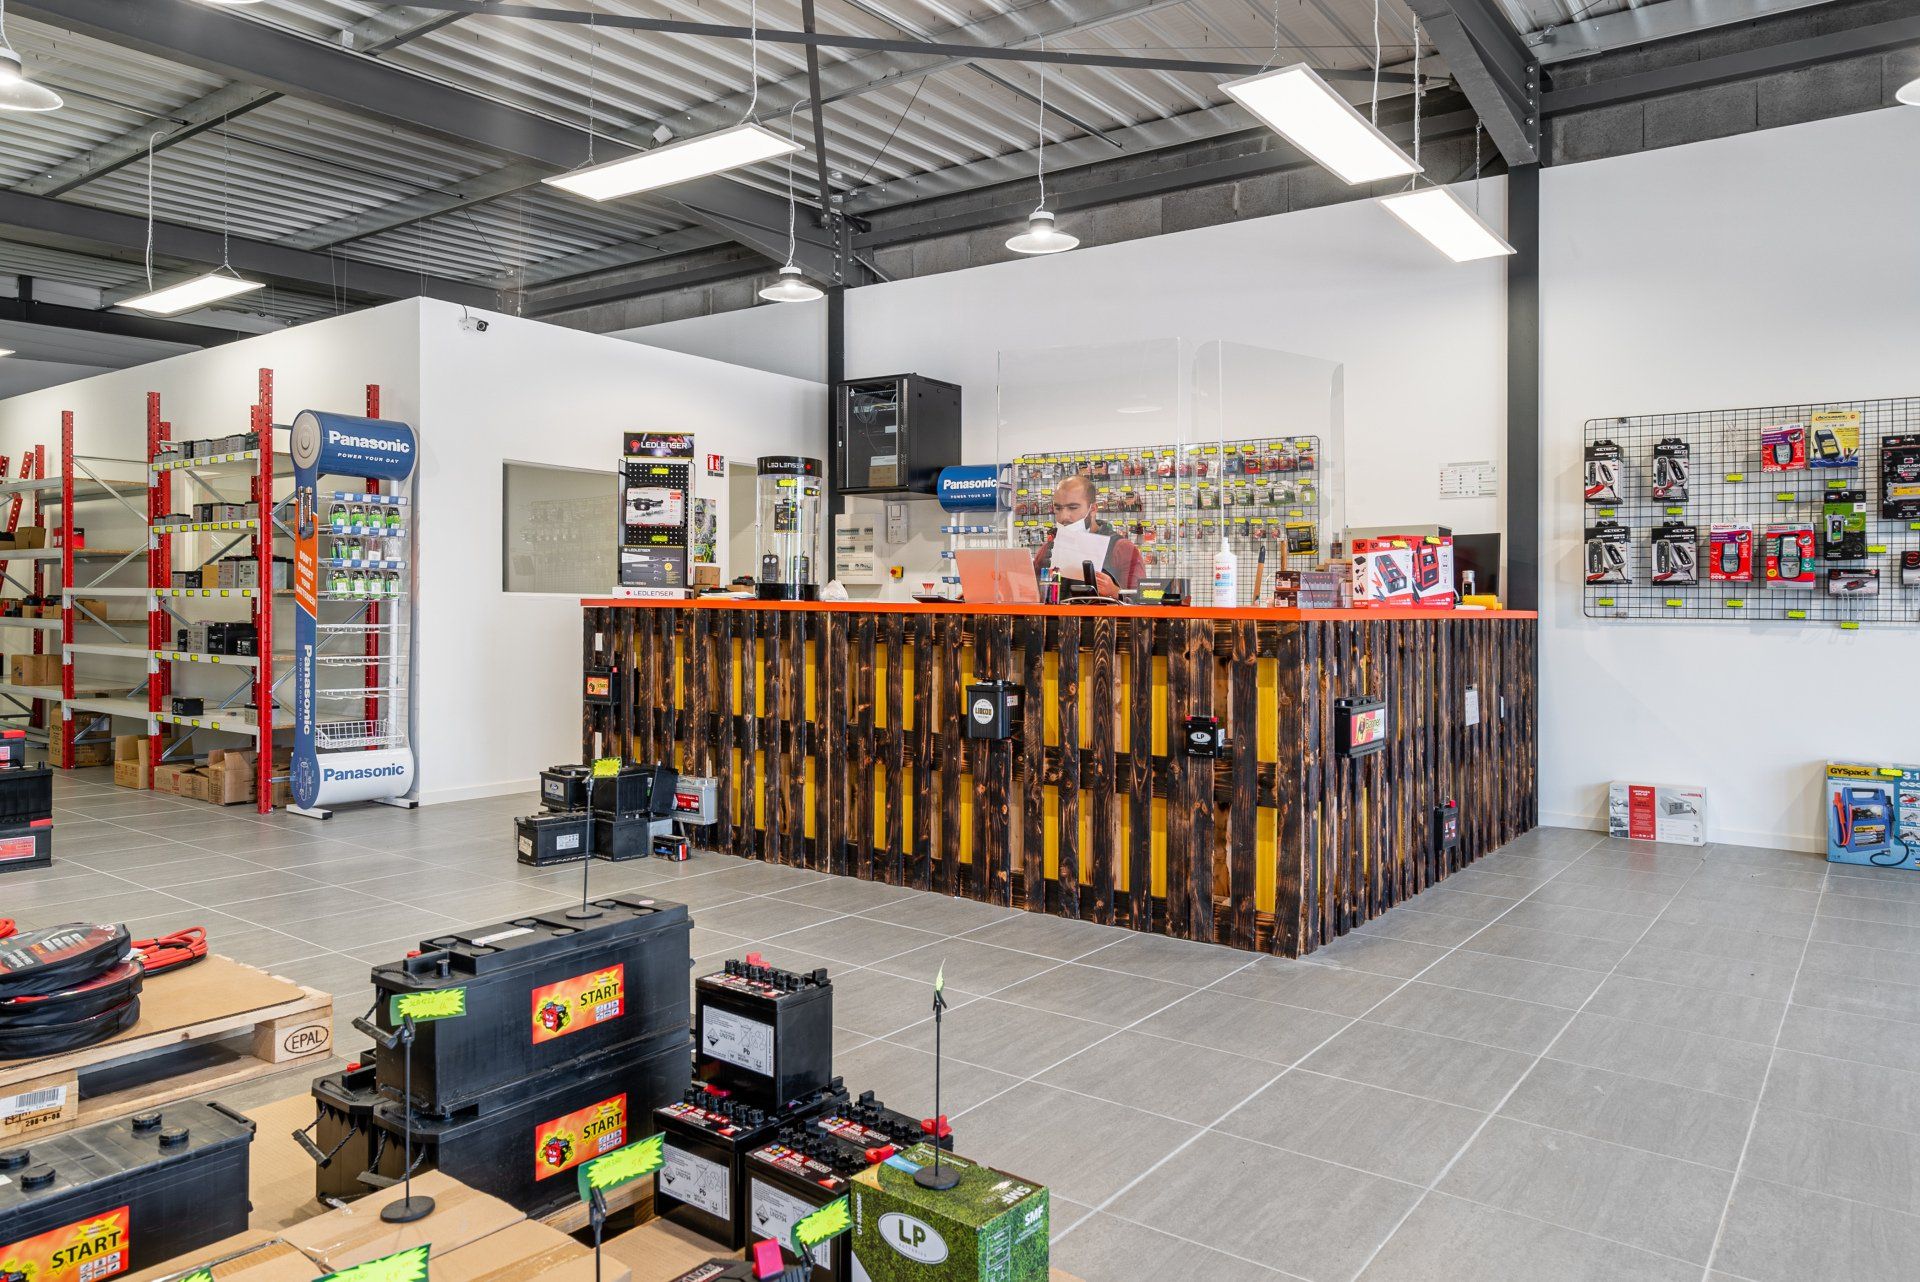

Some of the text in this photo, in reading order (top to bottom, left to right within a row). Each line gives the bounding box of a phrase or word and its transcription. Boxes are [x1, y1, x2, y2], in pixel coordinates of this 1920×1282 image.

[328, 430, 410, 453] Panasonic
[641, 441, 688, 449] LEDLENSER
[943, 477, 997, 490] Panasonic
[304, 644, 312, 735] Panasonic
[323, 763, 405, 782] Panasonic
[1830, 767, 1871, 777] GYSpack
[580, 982, 619, 1006] START
[291, 1029, 323, 1050] EPAL
[583, 1112, 623, 1139] START
[1024, 1204, 1044, 1227] SMF
[898, 1218, 927, 1248] LP
[51, 1230, 121, 1269] START
